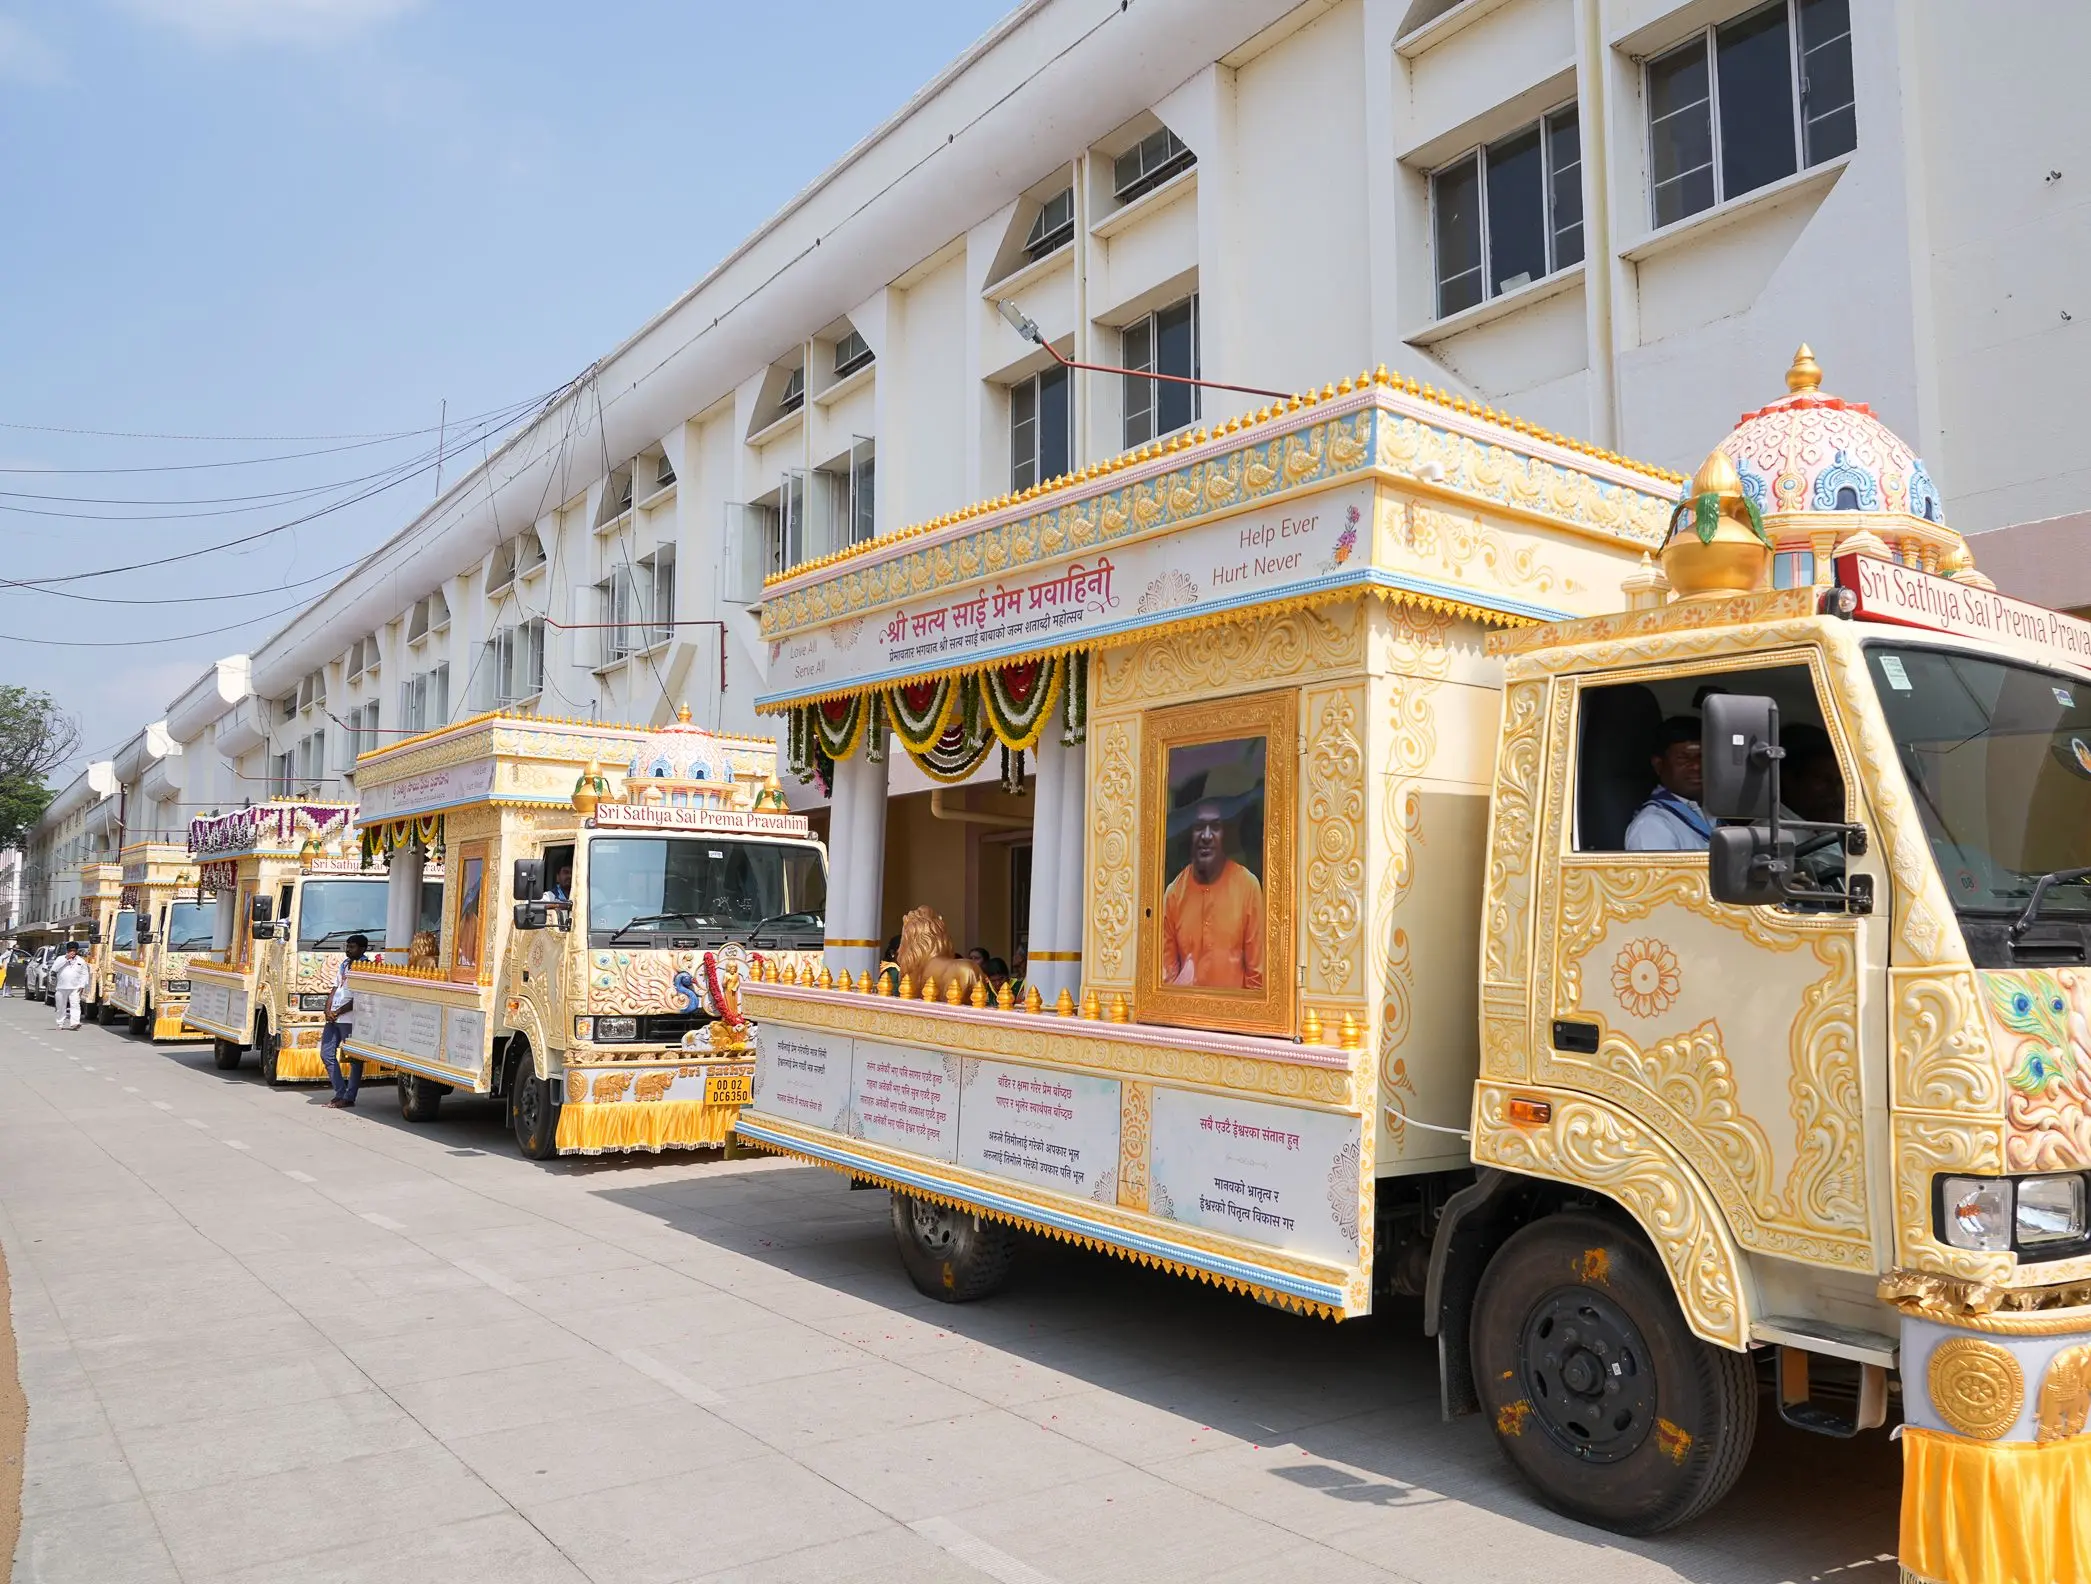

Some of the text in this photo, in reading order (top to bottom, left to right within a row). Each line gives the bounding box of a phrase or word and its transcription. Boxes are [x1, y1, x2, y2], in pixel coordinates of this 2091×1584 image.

[1240, 516, 1319, 549] Help Ever
[1213, 552, 1302, 586] Hurt Never
[880, 557, 1119, 644] श्री सत्य साई प्रेम प्रवाहिनी
[1859, 559, 1889, 603] Sri
[1893, 569, 1961, 628] Sathya
[1963, 589, 1991, 629] Sai
[1993, 597, 2047, 644] Prema
[599, 805, 808, 831] Sri Sathya Sai Prema Pravahini
[313, 859, 328, 869] Sri
[679, 1064, 755, 1078] Sri Sathya
[713, 1091, 748, 1102] DC6350
[731, 1079, 742, 1090] 02
[1200, 1114, 1213, 1131] सबै
[1215, 1118, 1231, 1134] एउटै
[1214, 1177, 1245, 1195] मानवको
[1273, 1190, 1280, 1203] र
[1252, 1206, 1281, 1228] विकास
